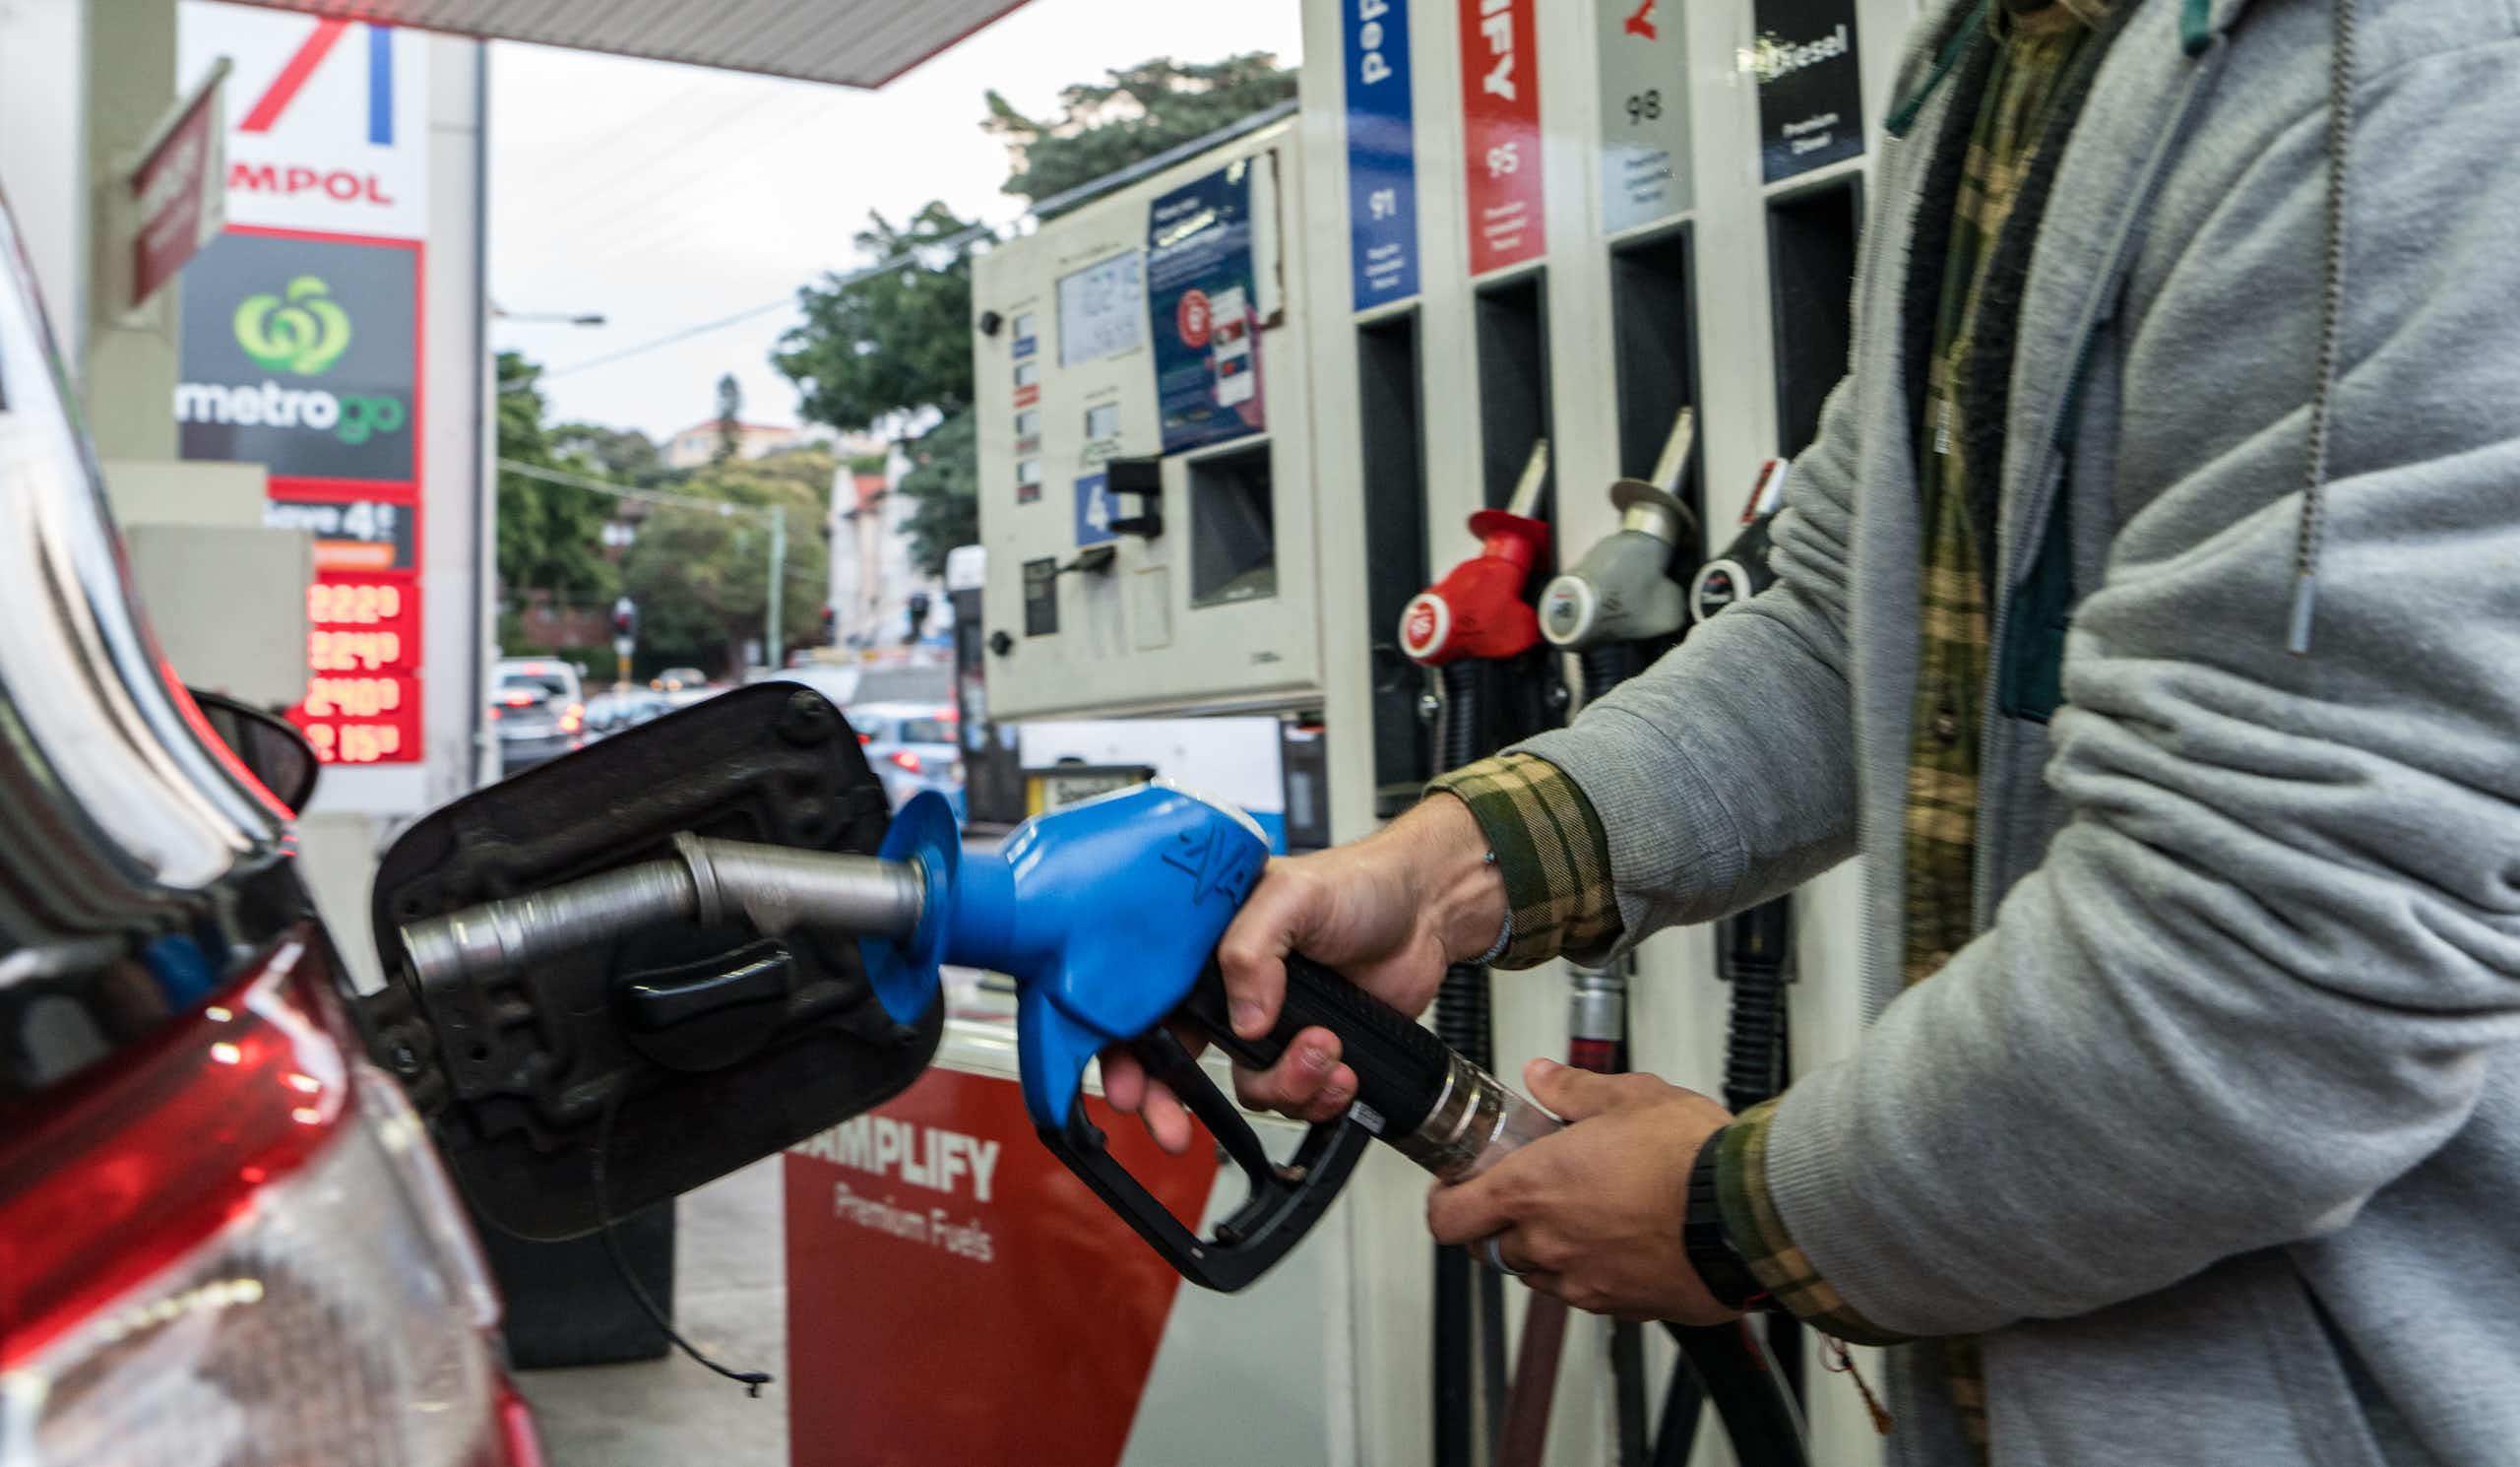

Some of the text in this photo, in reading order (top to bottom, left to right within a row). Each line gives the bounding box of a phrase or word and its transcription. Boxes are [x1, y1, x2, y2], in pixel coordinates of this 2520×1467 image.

[1626, 88, 1663, 127] 98
[226, 160, 395, 206] MPOL
[1485, 141, 1520, 179] 95
[1369, 187, 1398, 222] 91
[174, 379, 406, 445] metrogo
[1084, 483, 1112, 533] 4
[833, 1180, 993, 1263] Premium Fuels
